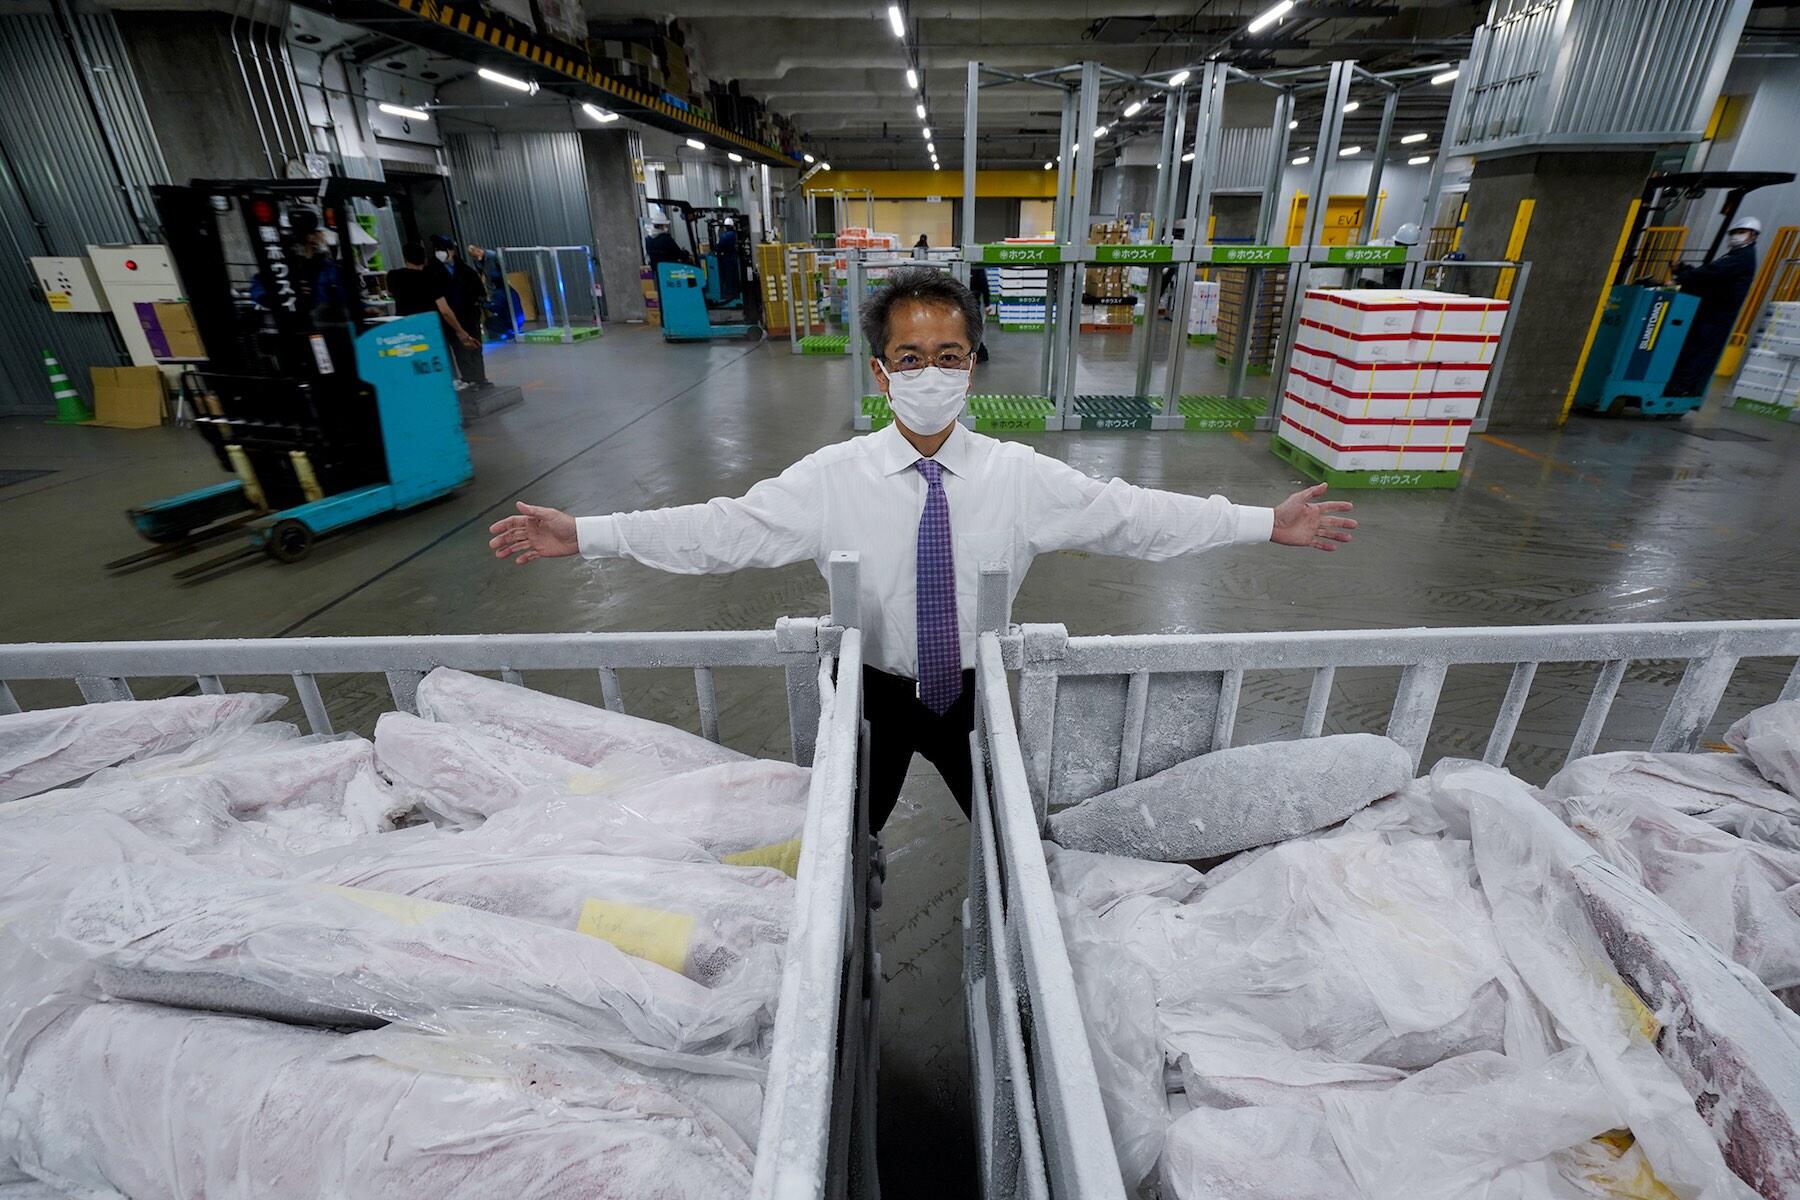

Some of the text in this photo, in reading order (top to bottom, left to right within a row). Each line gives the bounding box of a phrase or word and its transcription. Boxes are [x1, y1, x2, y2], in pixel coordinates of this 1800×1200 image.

[1009, 249, 1044, 260] ホウスイ
[1121, 249, 1157, 259] ホウスイ
[1236, 249, 1273, 260] ホウスイ
[1354, 249, 1391, 260] ホウスイ
[1638, 301, 1664, 350] SUMITOMO
[998, 420, 1032, 429] ホウスイ
[1104, 419, 1138, 428] ホウスイ
[1207, 419, 1241, 428] ホウスイ
[1380, 474, 1423, 486] ホウスイ
